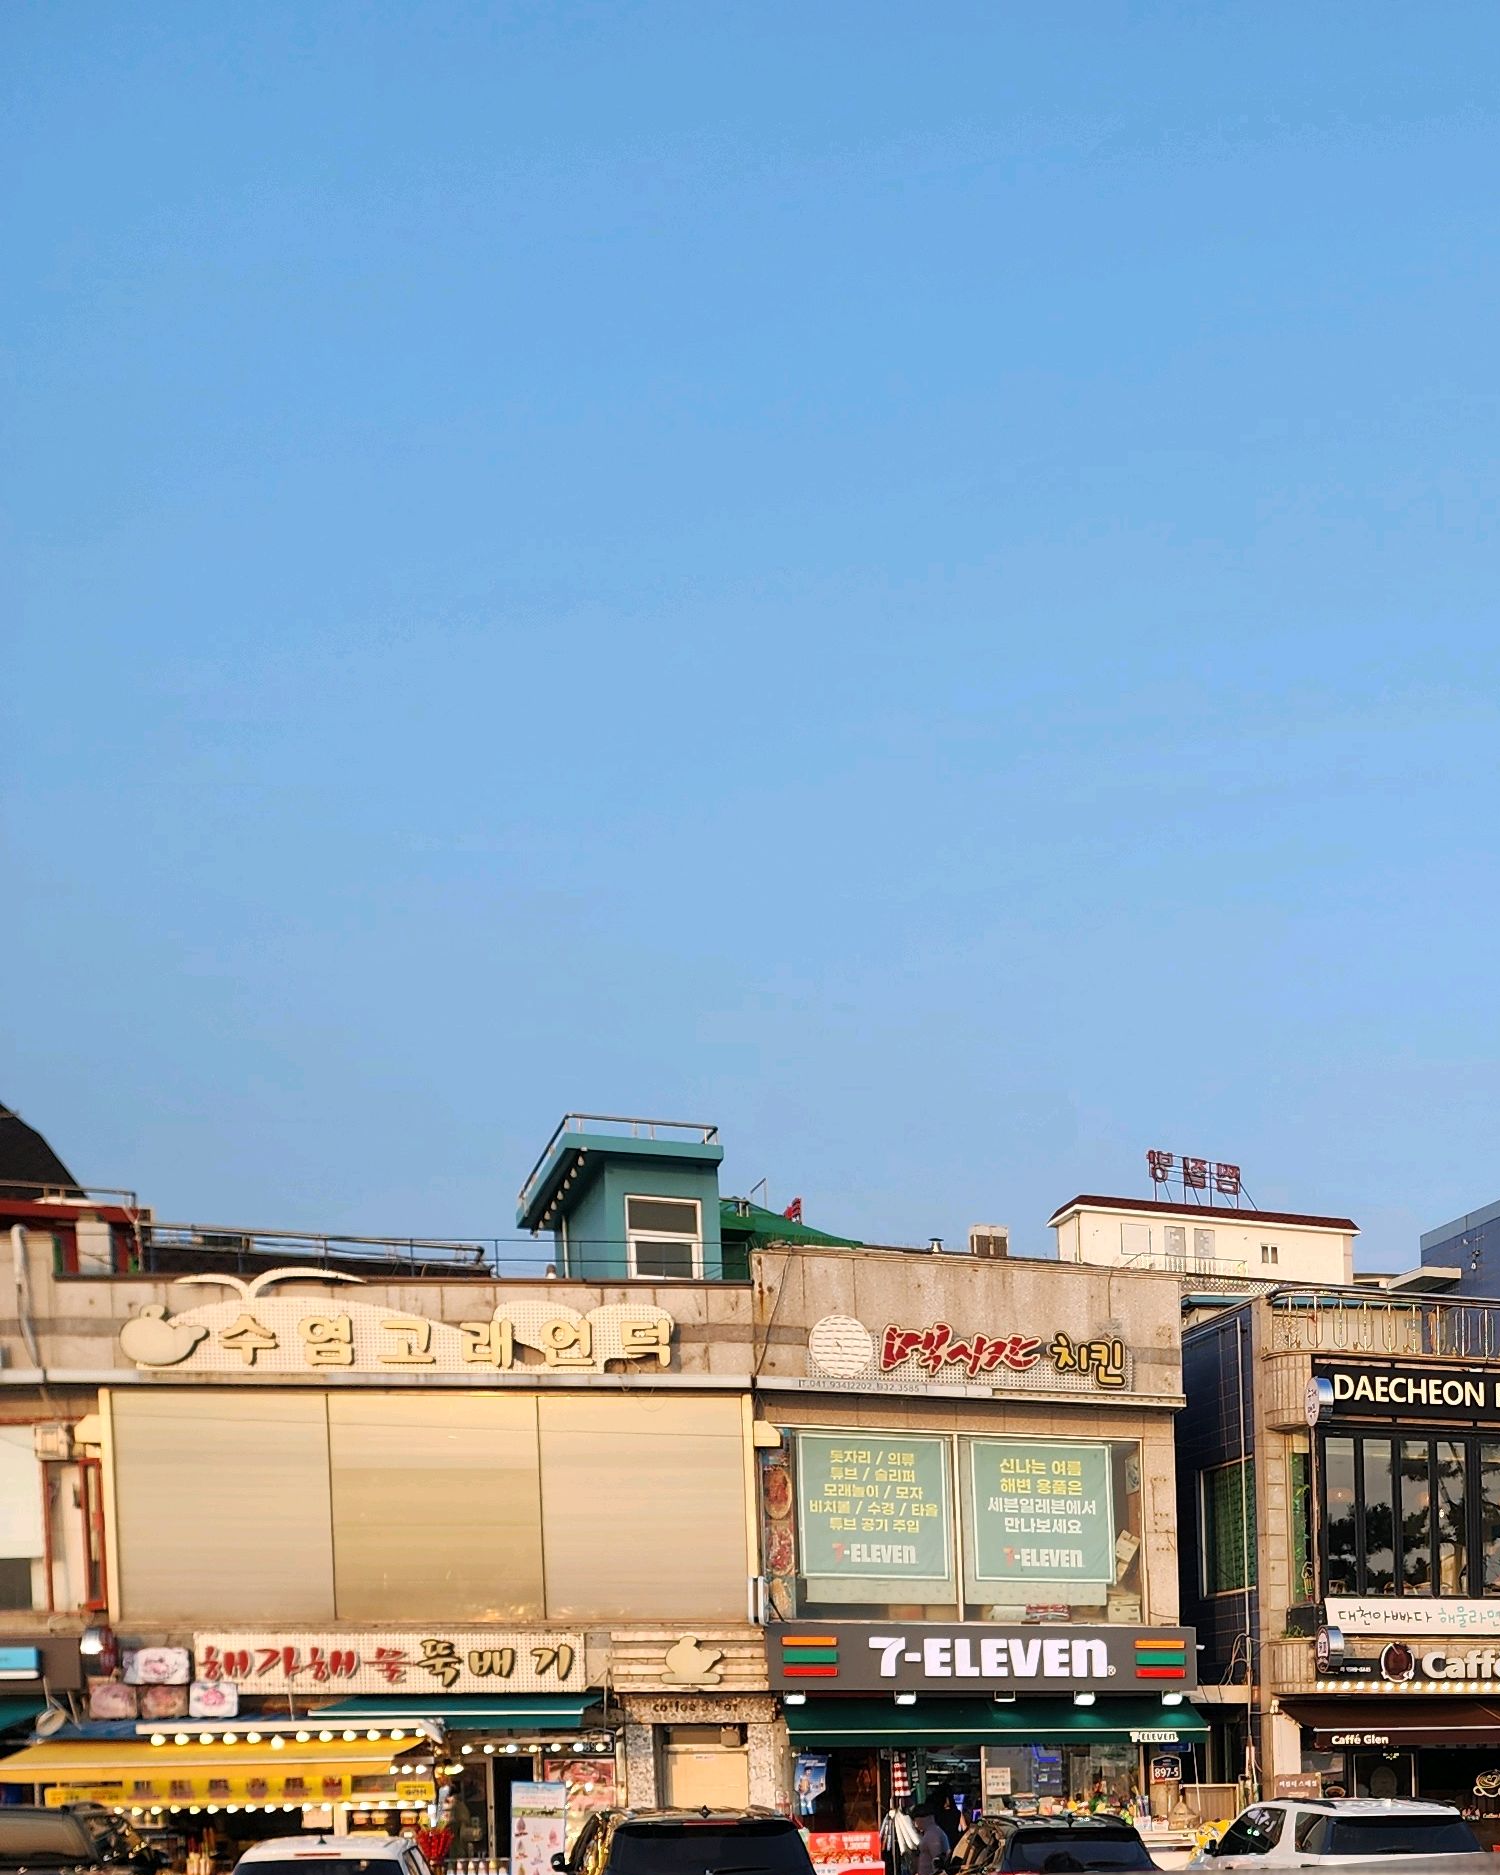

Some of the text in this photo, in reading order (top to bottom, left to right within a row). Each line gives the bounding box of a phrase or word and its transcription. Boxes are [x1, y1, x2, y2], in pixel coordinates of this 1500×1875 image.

[218, 1314, 673, 1368] 수염고래언덕
[1048, 1330, 1126, 1387] 치킨
[1334, 1373, 1485, 1408] DAECHEON
[830, 1450, 871, 1464] 돗자리
[887, 1453, 915, 1466] 의류
[830, 1467, 858, 1480] 튜브
[875, 1469, 915, 1483] 슬리퍼
[1000, 1458, 1082, 1476] 신나는 여름
[824, 1484, 879, 1498] 모래놀이
[896, 1486, 923, 1500] 모자
[1000, 1478, 1083, 1496] 해변 용품은
[809, 1500, 850, 1514] 비치볼
[868, 1503, 895, 1516] 수경
[987, 1497, 1096, 1515] 세븐일레븐에서
[830, 1517, 920, 1533] 튜브 공기 주입
[1004, 1518, 1083, 1534] 만나보세요
[1364, 1733, 1389, 1744] Glen
[1154, 1766, 1179, 1778] 897-5
